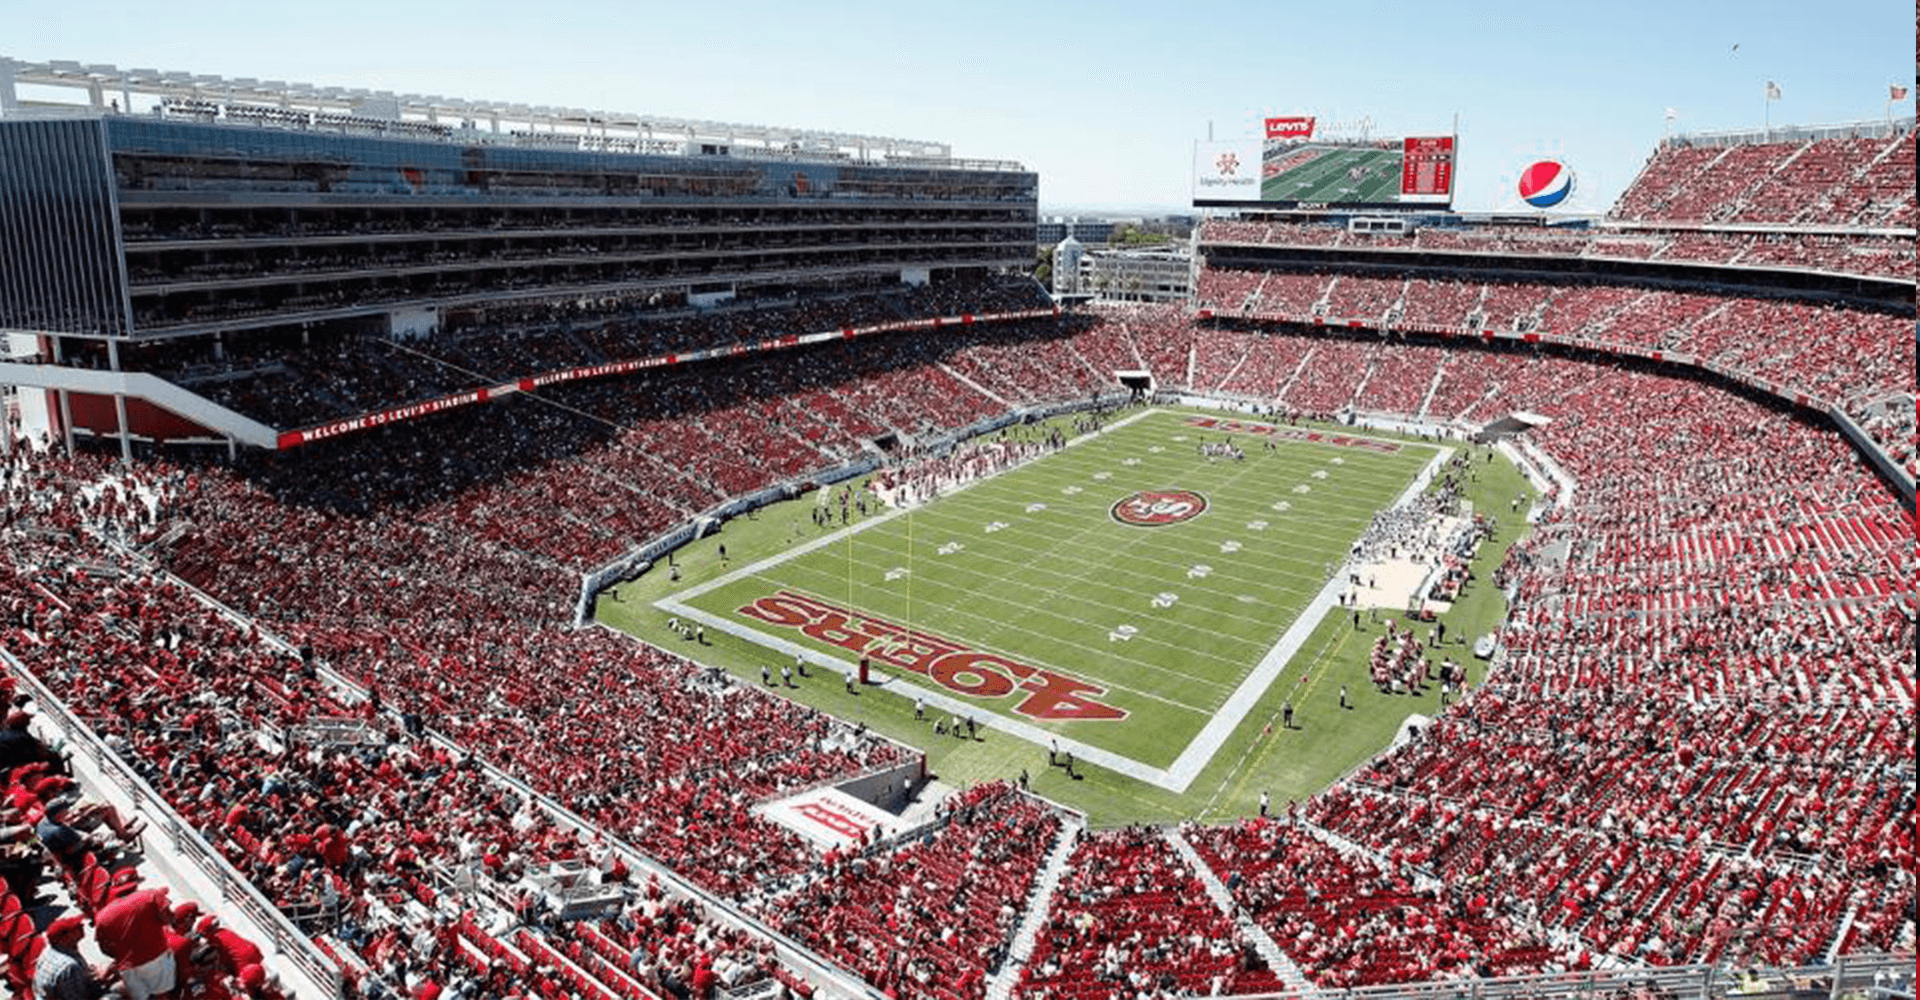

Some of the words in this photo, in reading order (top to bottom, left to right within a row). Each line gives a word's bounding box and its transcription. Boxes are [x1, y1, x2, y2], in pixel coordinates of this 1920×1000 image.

[533, 371, 575, 386] WELCOME
[578, 369, 590, 378] TO
[628, 358, 668, 370] STADIUM
[301, 418, 367, 441] WELCOME
[370, 414, 386, 426] TO
[432, 393, 478, 411] STADIUM
[733, 590, 1131, 722] 49ERS
